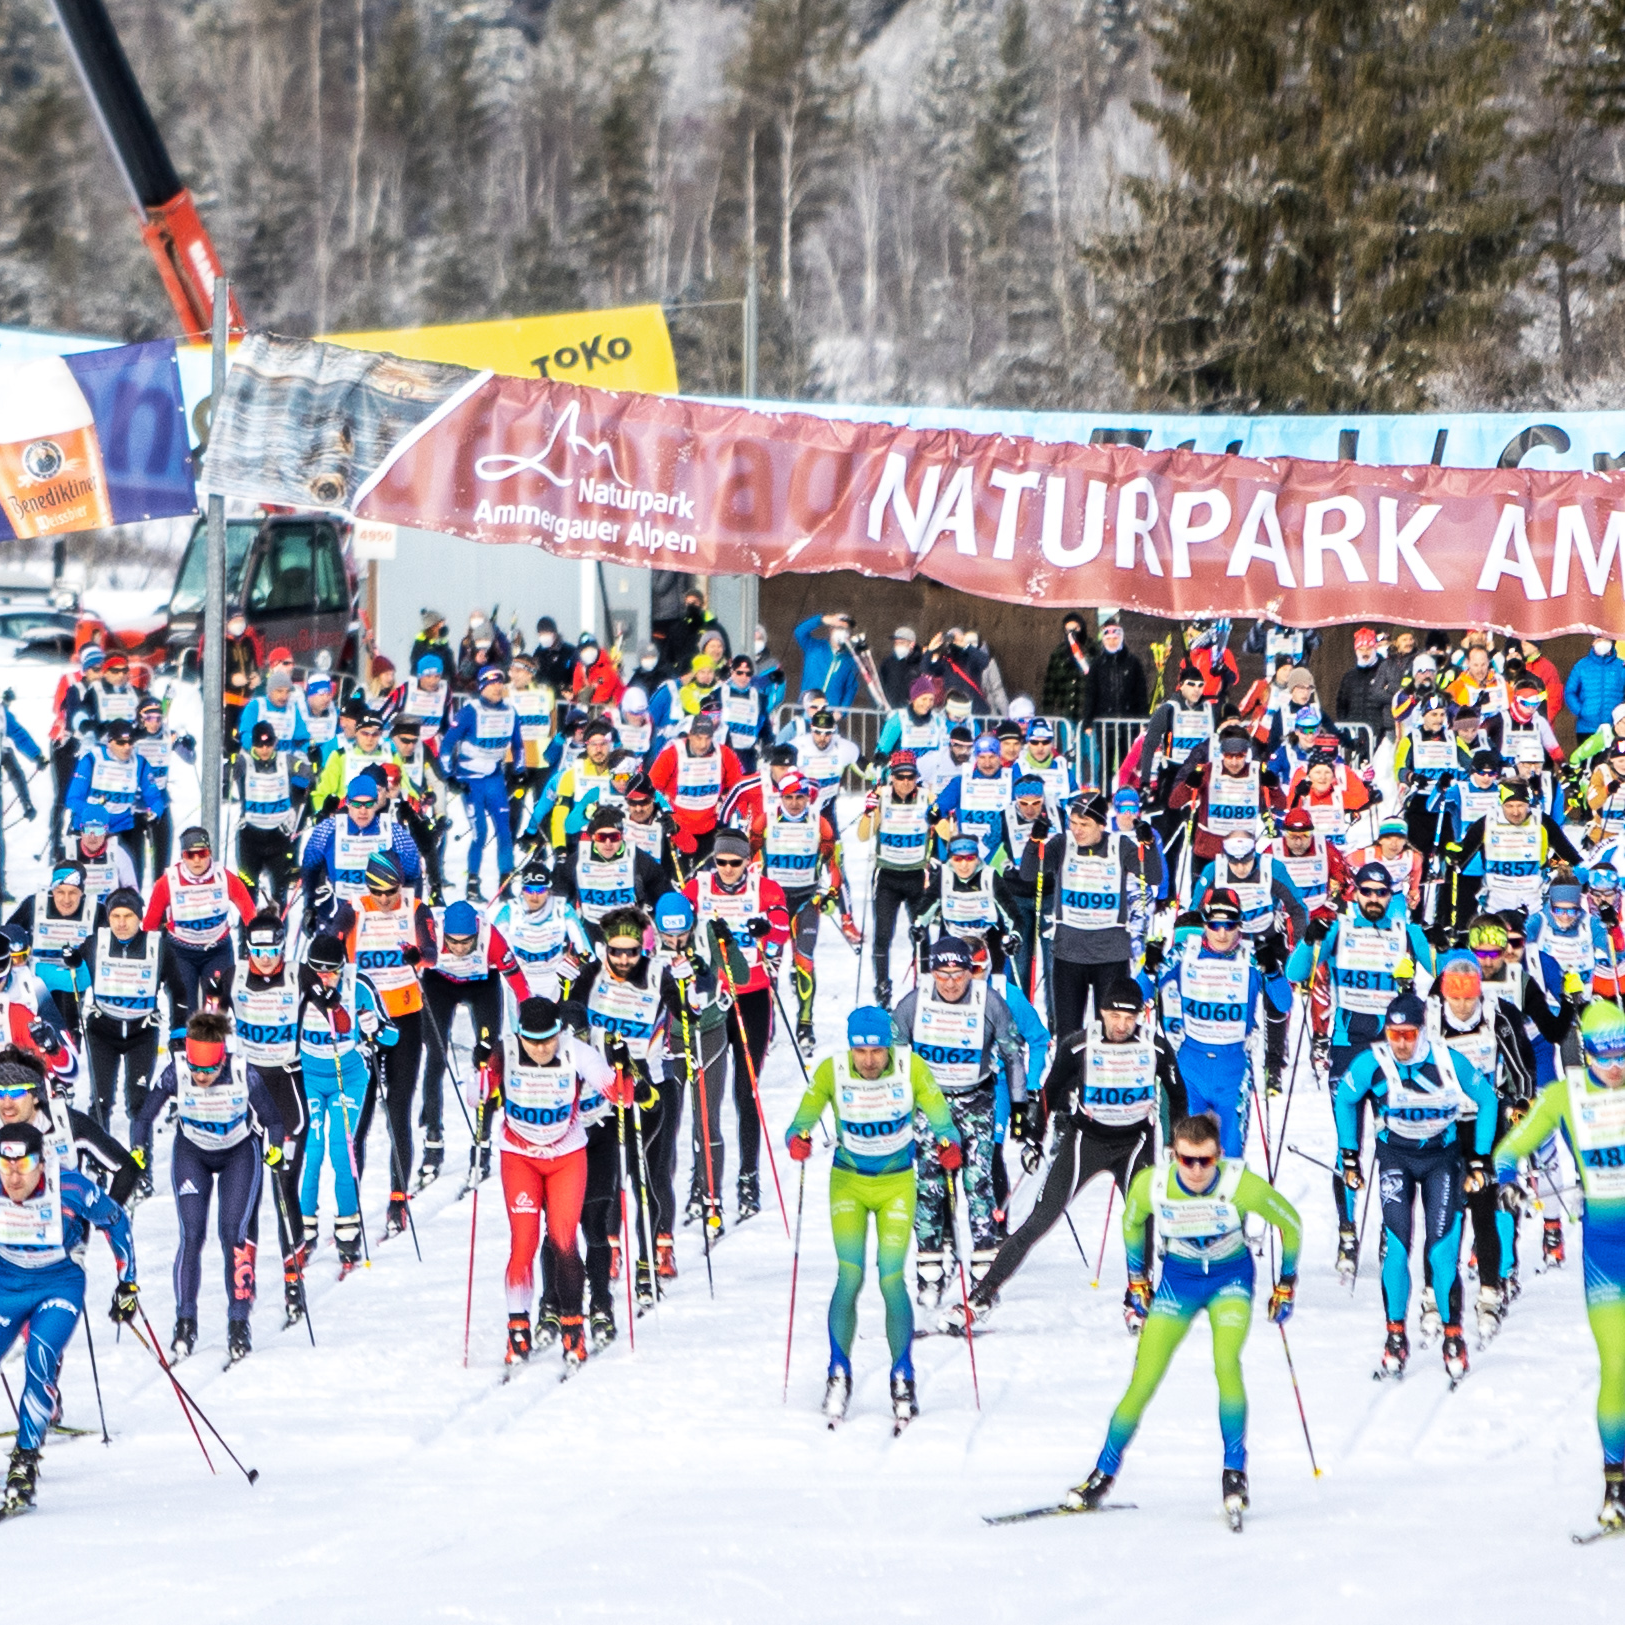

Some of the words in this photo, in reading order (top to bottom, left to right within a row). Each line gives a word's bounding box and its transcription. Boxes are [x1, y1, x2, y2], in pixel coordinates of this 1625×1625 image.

[531, 333, 634, 377] TOKO
[8, 476, 97, 520] Benediktiner
[578, 477, 696, 520] Naturpark
[473, 499, 620, 544] Ammergauer
[625, 521, 697, 555] Alpen
[865, 452, 1447, 592] NATURPARK
[358, 530, 393, 542] 4950
[1212, 805, 1255, 819] 4089
[768, 855, 815, 870] 4107
[1490, 860, 1537, 877] 4857
[585, 887, 631, 905] 4345
[1063, 890, 1114, 909] 4099
[937, 952, 964, 964] VITAL
[1184, 1000, 1241, 1024] 4060
[239, 1023, 294, 1043] 4024
[916, 1044, 973, 1064] 6062
[1088, 1086, 1147, 1105] 4064
